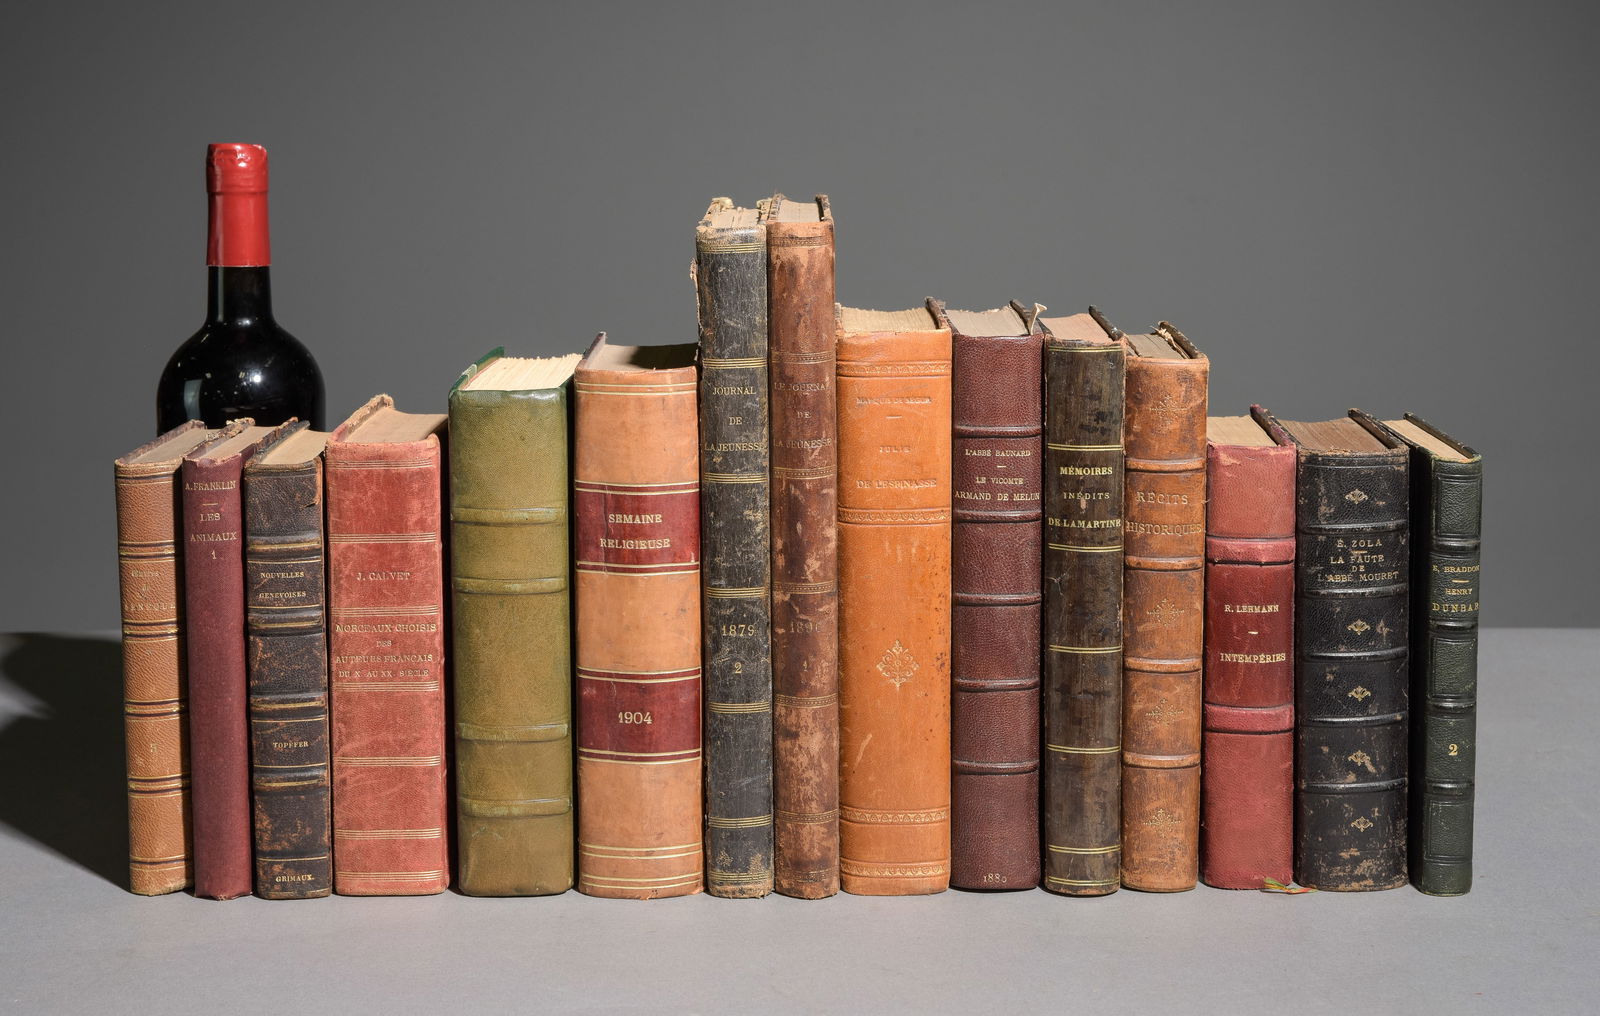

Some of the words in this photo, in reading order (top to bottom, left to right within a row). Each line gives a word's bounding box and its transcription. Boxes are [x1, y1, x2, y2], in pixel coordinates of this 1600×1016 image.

[712, 385, 757, 396] JOURNAL
[797, 411, 812, 419] DE
[728, 416, 743, 426] DE
[1059, 465, 1113, 476] MÉMOIRES
[976, 476, 987, 484] LE
[990, 477, 1024, 485] VICOMTE
[954, 490, 992, 501] ARMAND
[997, 493, 1009, 501] DE
[200, 512, 221, 522] LES
[608, 513, 663, 524] SEMAINE
[1048, 517, 1060, 527] DE
[1063, 518, 1121, 529] LAMARTINE
[190, 531, 238, 542] ANIMAUX
[600, 538, 671, 550] RELIGIEUSE
[1351, 539, 1383, 548] ZOLA
[211, 549, 217, 560] 1
[1329, 556, 1345, 564] LA
[1350, 554, 1385, 564] FAUTE
[1351, 565, 1366, 573] DE
[260, 571, 305, 579] NOUVELLES
[368, 572, 410, 581] CALVET
[1359, 571, 1400, 582] MOURET
[259, 590, 307, 599] GENEVOISES
[1445, 588, 1473, 596] HENRY
[1224, 604, 1234, 613] R.
[1236, 604, 1279, 613] LEHMANN
[1431, 602, 1480, 613] DUNBAR
[335, 623, 392, 633] MORCEAUX
[395, 623, 437, 633] CHOISIS
[1220, 652, 1286, 664] INTEMPÉRIES
[734, 661, 743, 674] 2
[618, 711, 653, 725] 1904
[1448, 743, 1458, 756] 2
